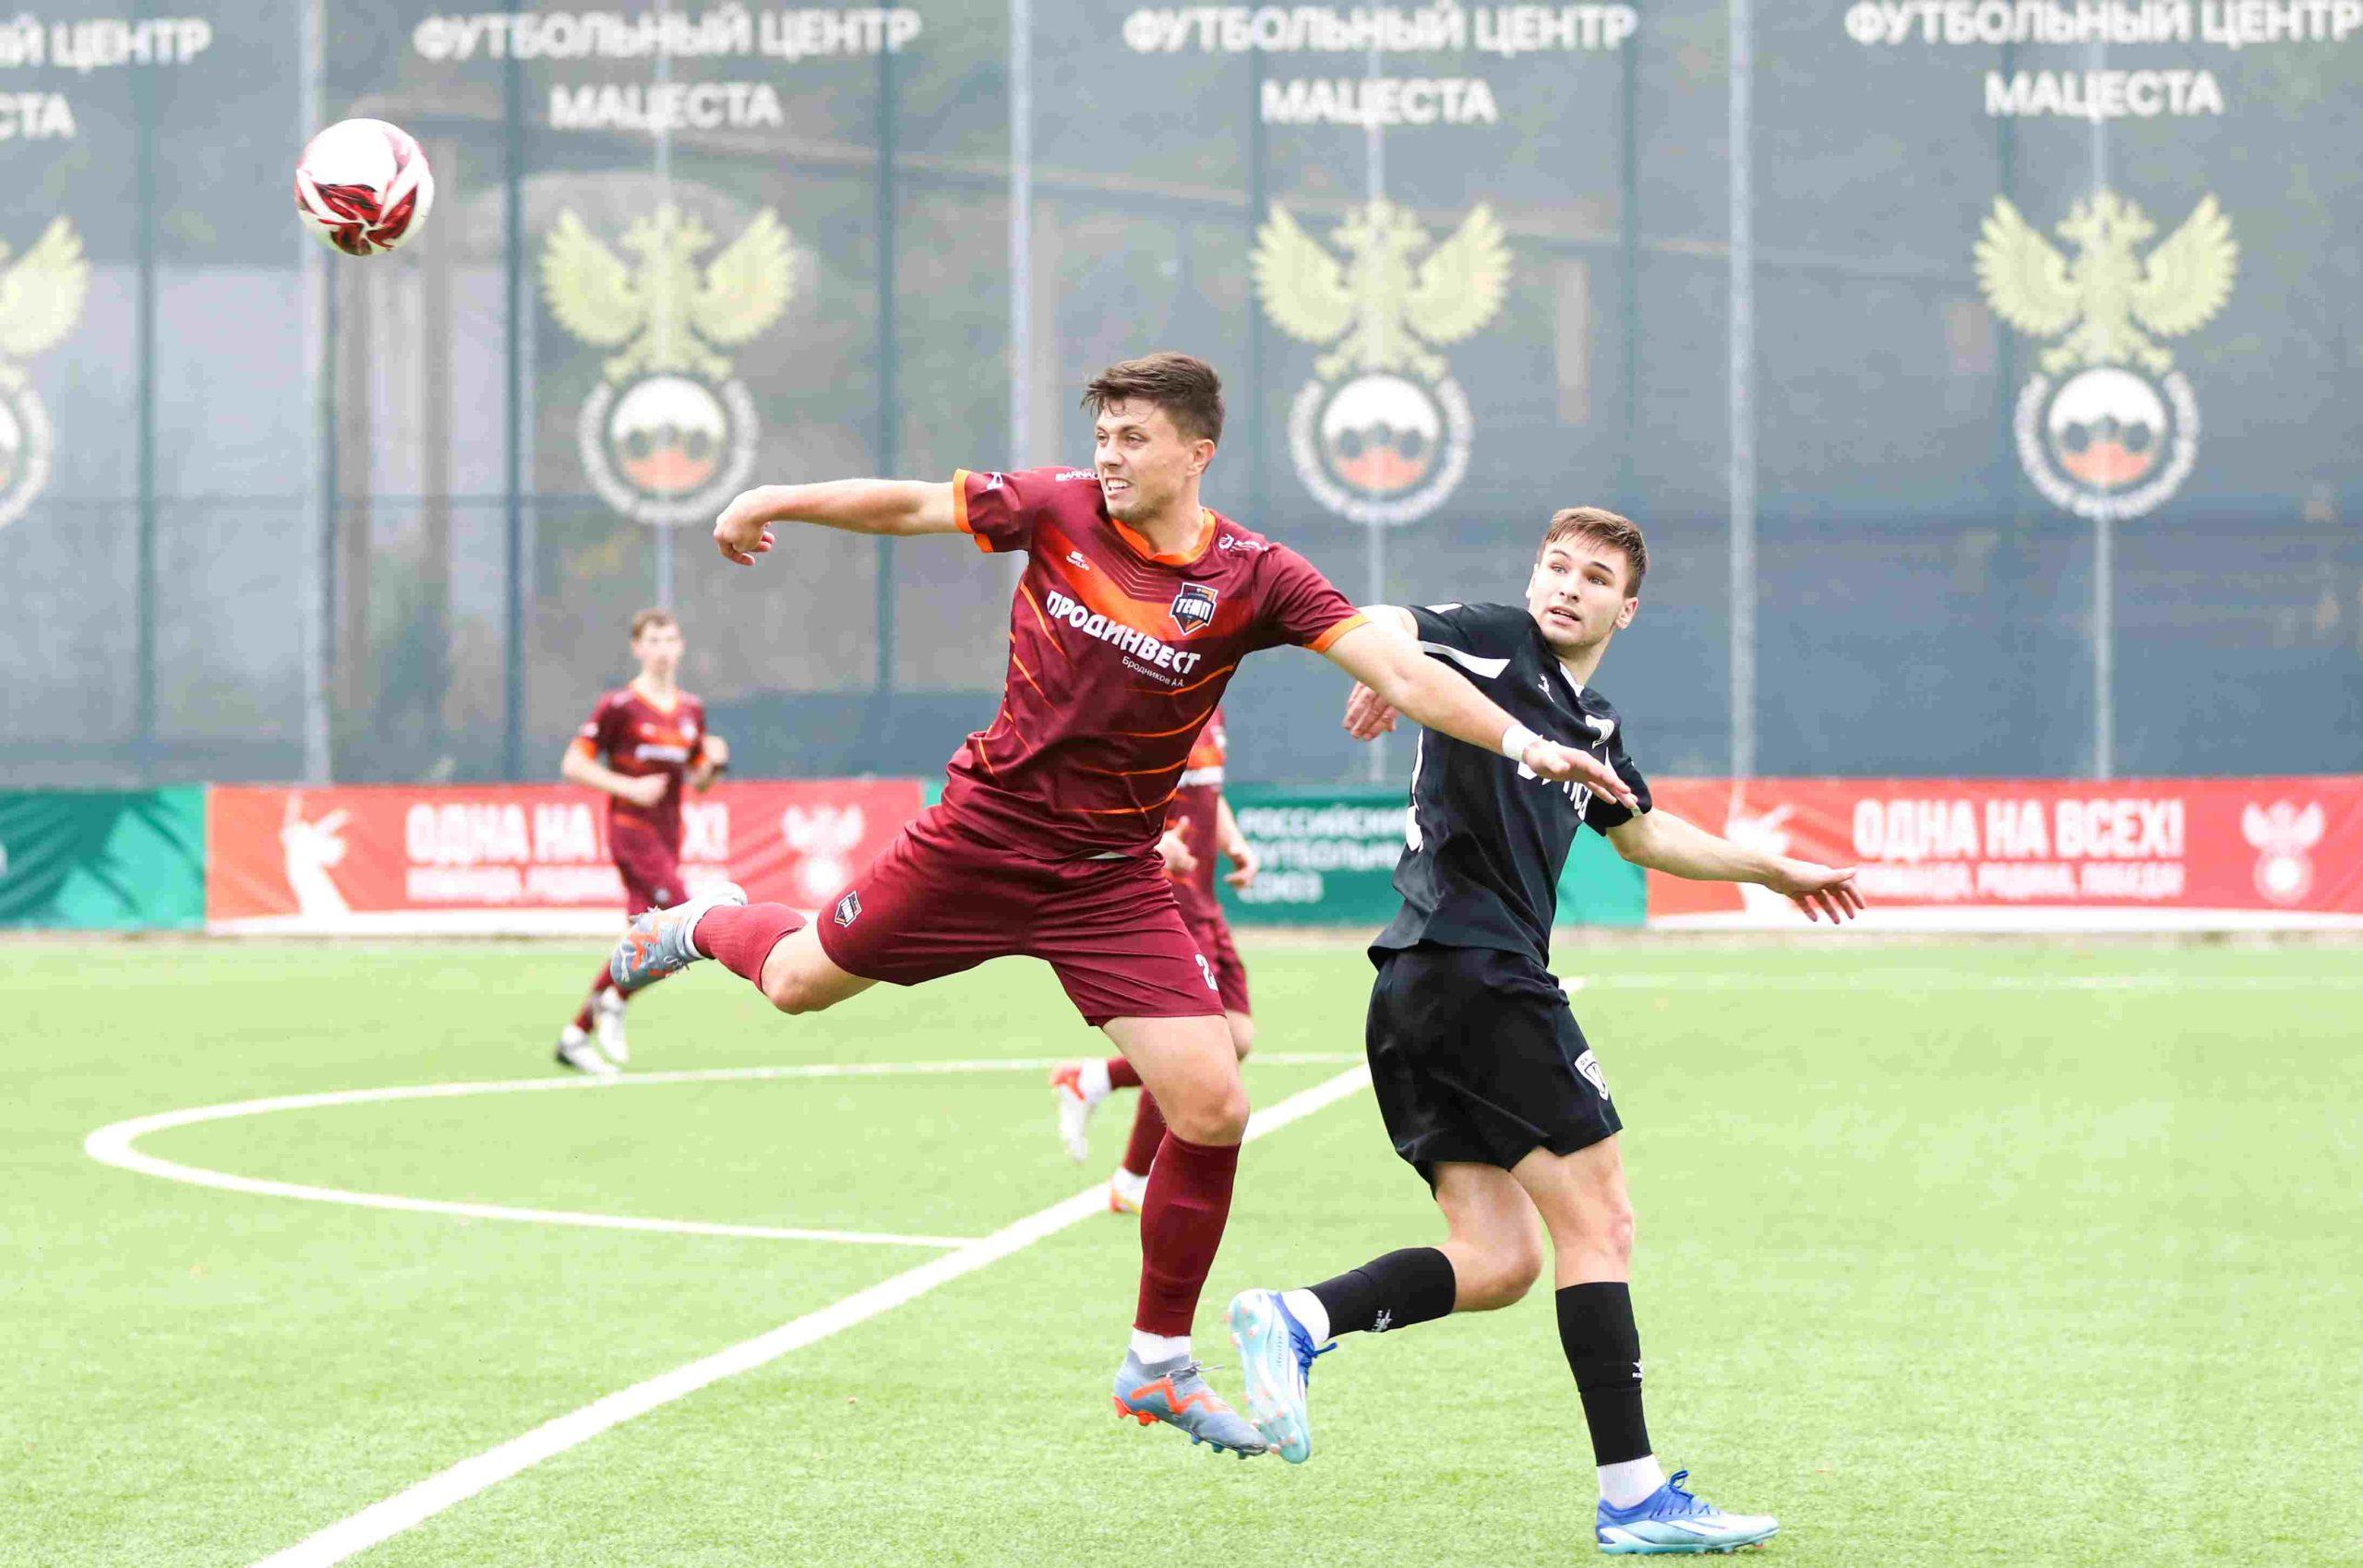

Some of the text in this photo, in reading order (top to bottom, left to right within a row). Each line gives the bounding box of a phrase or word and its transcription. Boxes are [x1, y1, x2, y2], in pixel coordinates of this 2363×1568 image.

[52, 18, 212, 74] ЦЕНТР
[414, 3, 920, 62] ФУТБОЛЬНЫЙ ЦЕНТР
[1123, 0, 1638, 57] ФУТБОЛЬНЫЙ ЦЕНТР
[2201, 0, 2363, 49] ЦЕНТР
[550, 83, 784, 134] МАЦЕСТА
[1260, 78, 1499, 127] МАЦЕСТА
[1985, 69, 2224, 123] МАЦЕСТА
[1046, 590, 1201, 674] ПРОДИНВЕСТ
[1176, 598, 1212, 620] ТЕМП
[1122, 656, 1170, 685] Бродников
[406, 803, 531, 865] ОДНА
[533, 803, 598, 863] НА
[1237, 803, 1408, 837] РОССИЙСКИ
[1853, 797, 2185, 864] ОДНА НА ВСЕХ!
